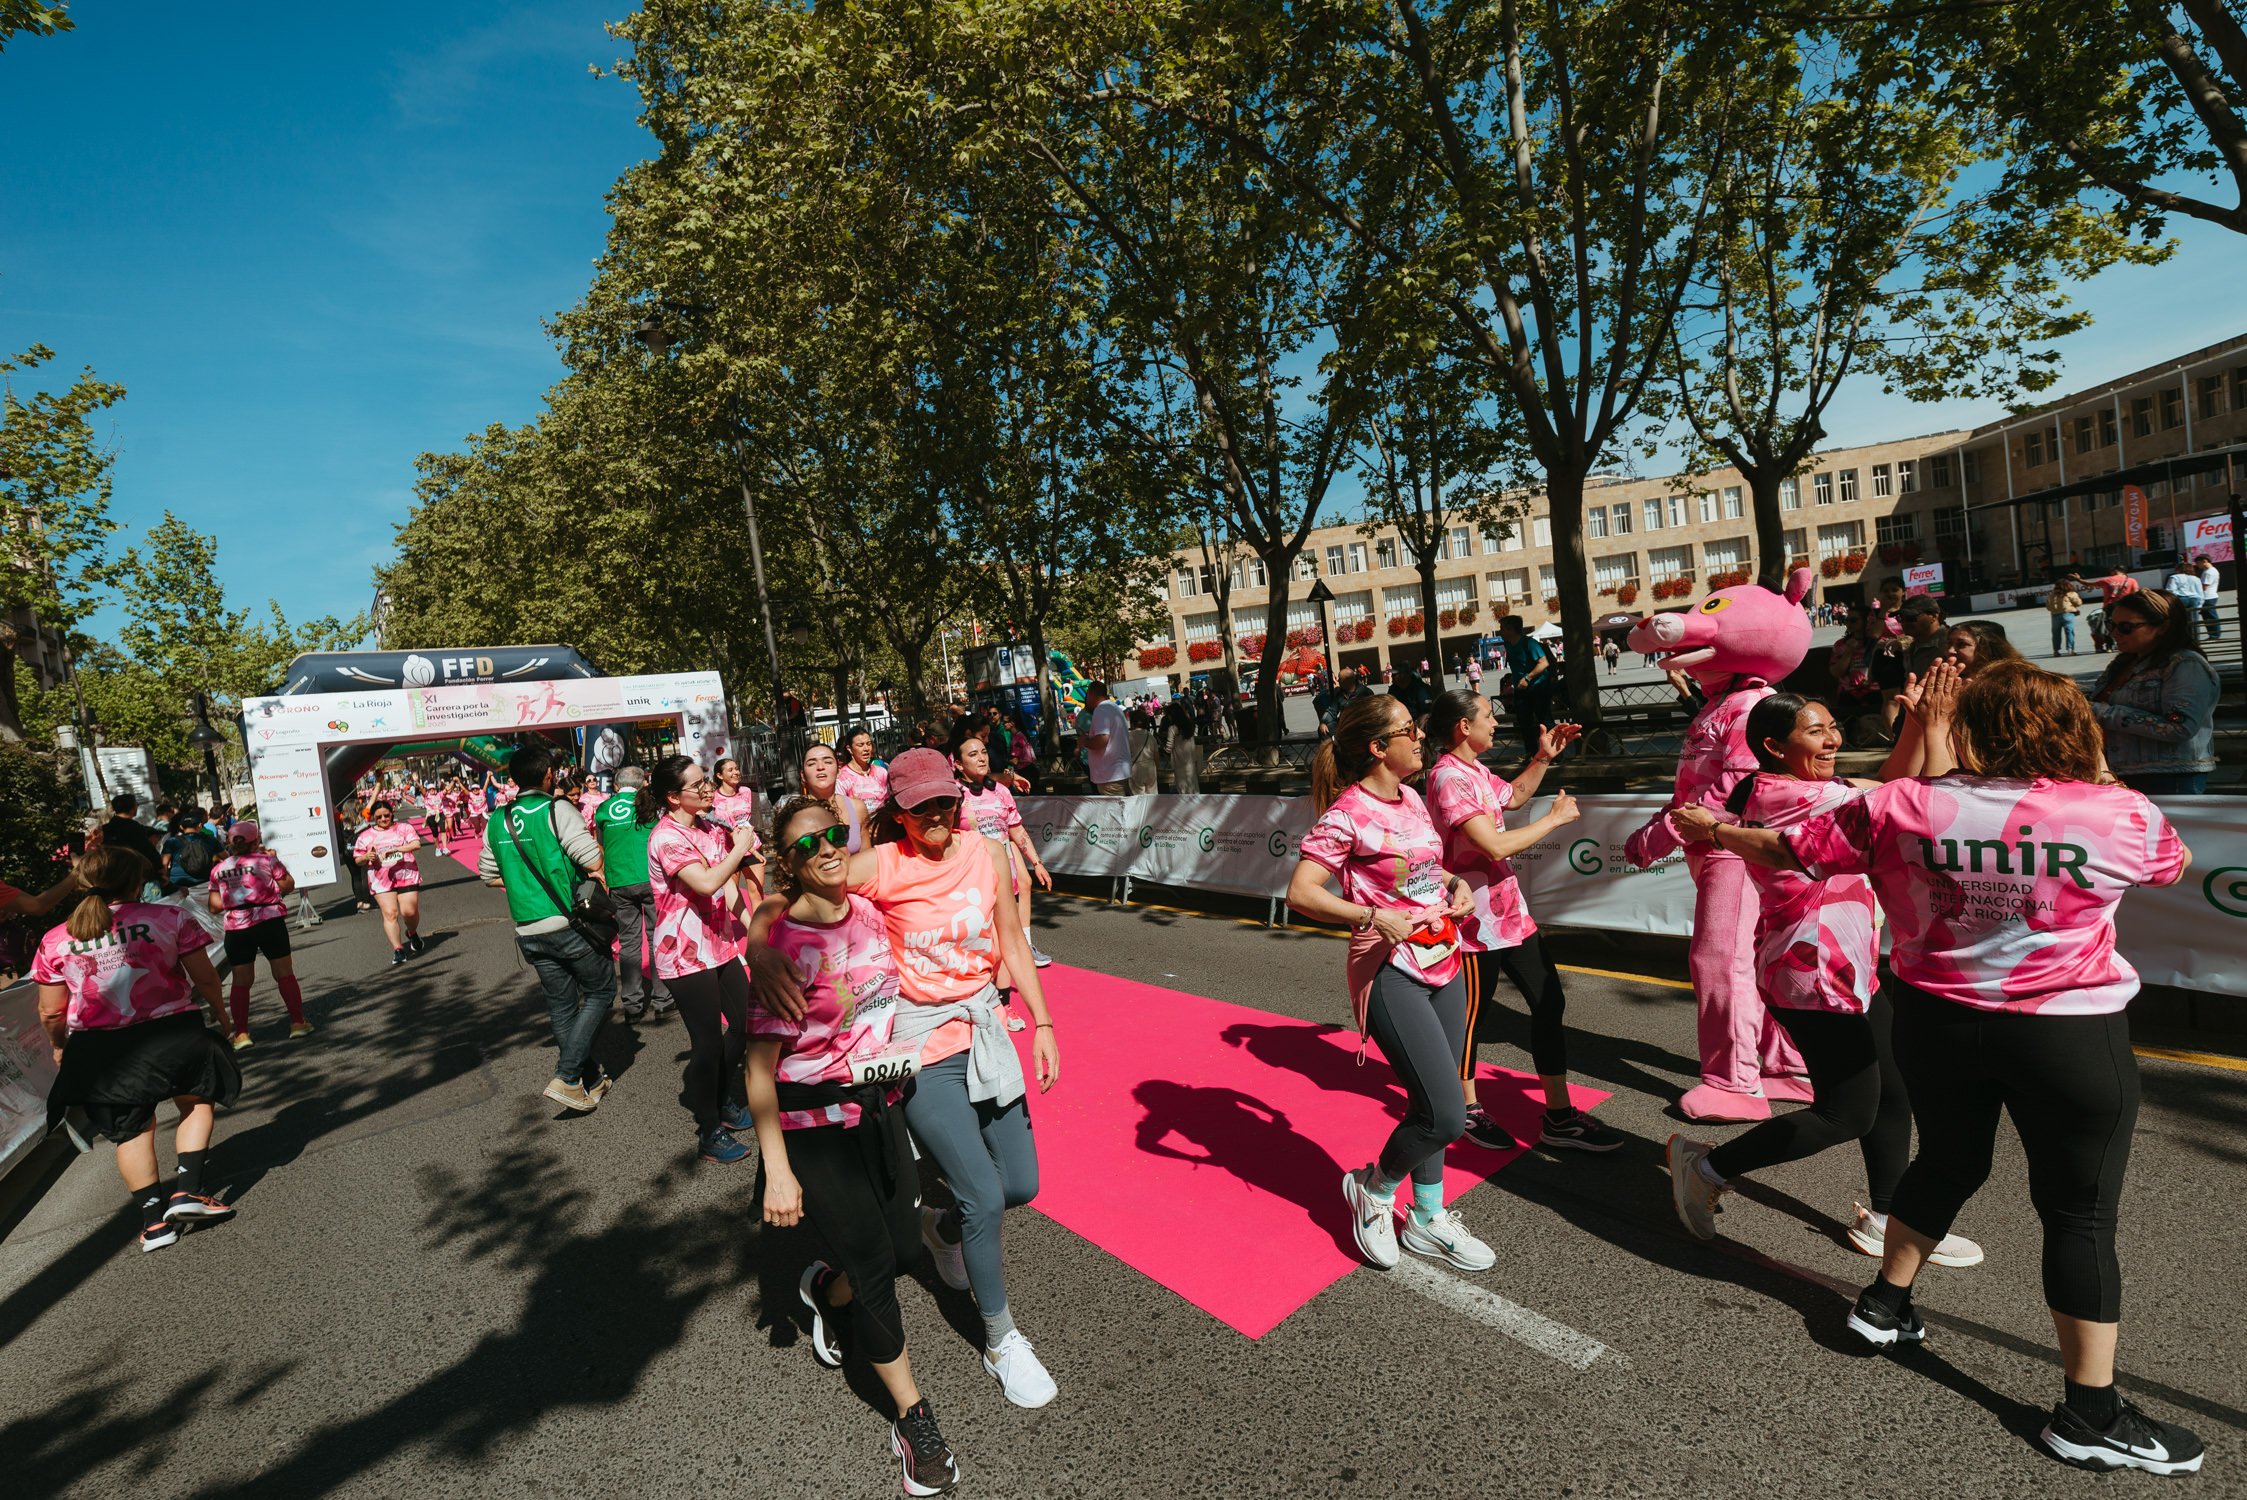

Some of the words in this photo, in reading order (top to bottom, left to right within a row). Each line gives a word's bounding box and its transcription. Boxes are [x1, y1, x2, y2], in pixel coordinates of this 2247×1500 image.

[2196, 520, 2232, 539] Ferr
[1909, 568, 1935, 582] Ferrer
[441, 656, 494, 678] FFD
[367, 700, 393, 708] Rioja
[424, 695, 437, 704] XI
[695, 694, 719, 703] Ferrer
[425, 703, 461, 712] Carrera
[463, 703, 478, 712] por
[426, 709, 489, 721] investigación
[1217, 838, 1232, 846] contra
[1530, 840, 1561, 852] pañola
[1515, 853, 1543, 862] cáncer
[1656, 853, 1688, 864] cánce
[1408, 856, 1436, 873] Carrera
[1609, 866, 1622, 874] en
[1624, 865, 1636, 874] La
[1407, 876, 1420, 888] por
[1421, 872, 1428, 882] la
[1927, 877, 2033, 895] UNIVERSIDAD
[1929, 890, 2058, 912] INTERNACIONAL
[1930, 902, 1945, 915] DE
[1946, 905, 1969, 917] LA
[1975, 909, 2021, 923] RIOJA
[904, 927, 945, 949] HOY
[103, 962, 127, 973] RIOJA
[852, 972, 886, 997] Carrera
